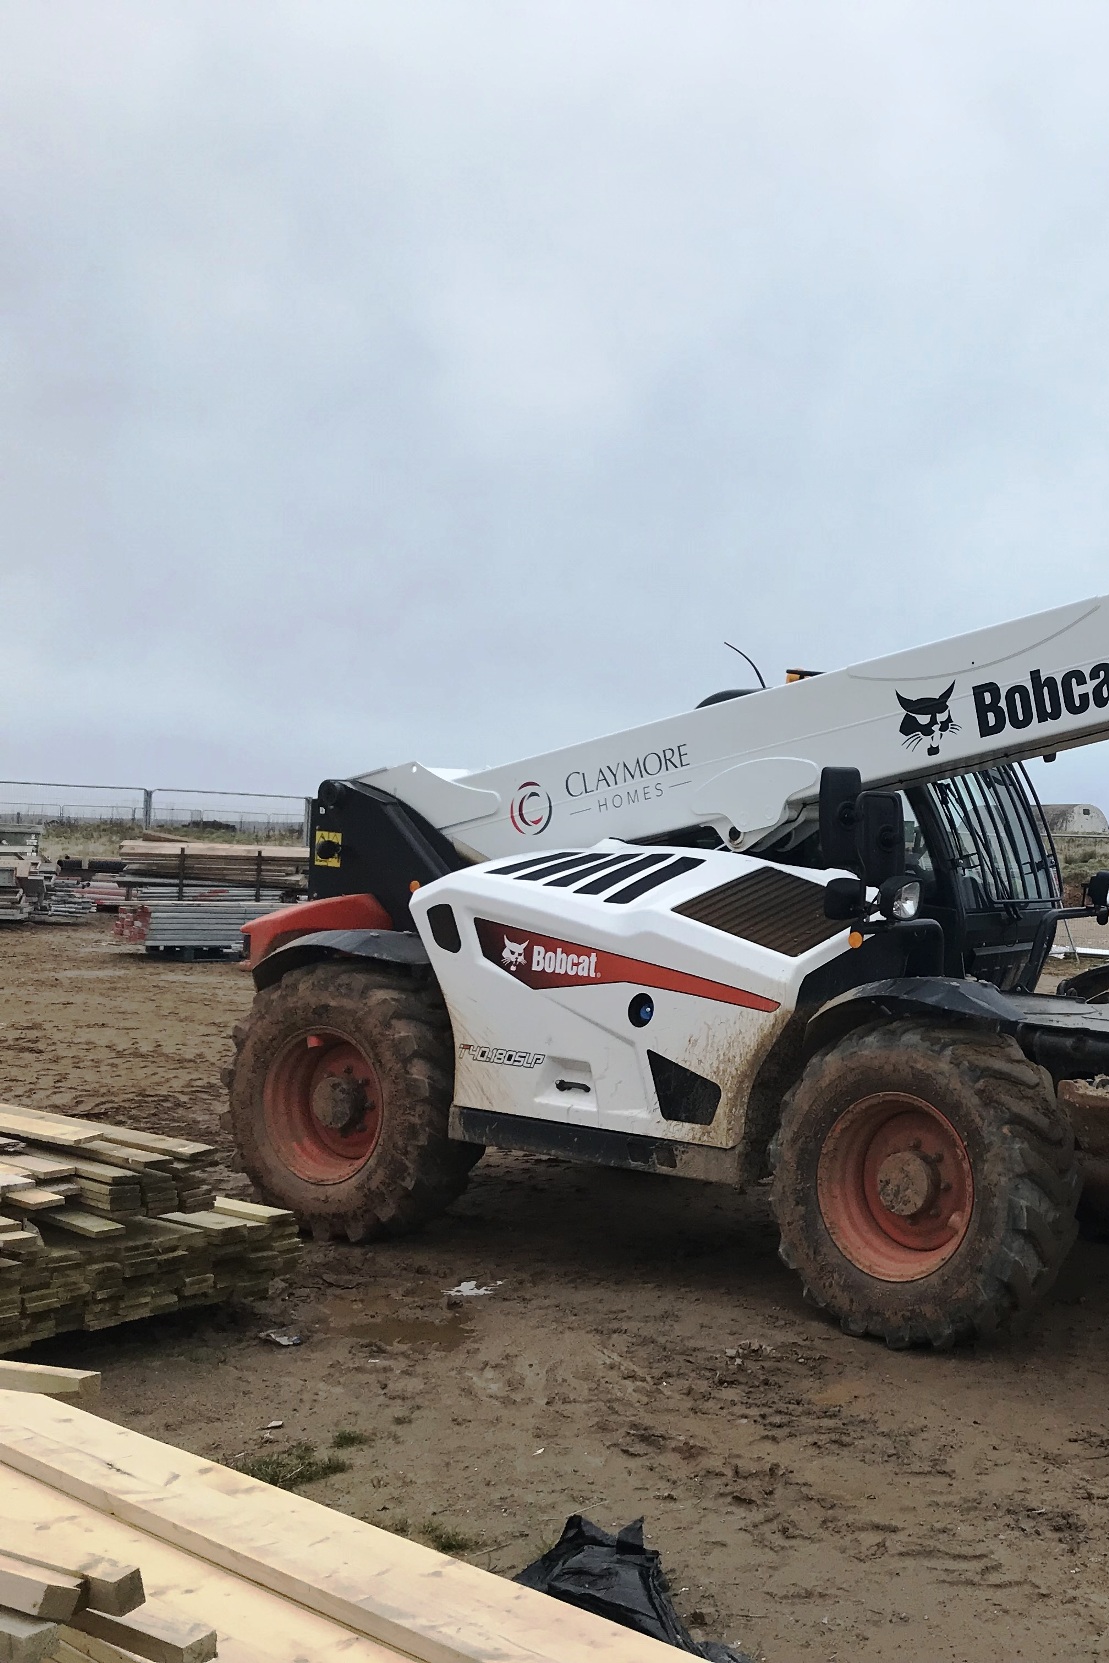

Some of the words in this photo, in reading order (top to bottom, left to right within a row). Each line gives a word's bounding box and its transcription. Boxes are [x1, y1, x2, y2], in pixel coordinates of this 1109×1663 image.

[566, 744, 690, 797] CLAYMORE
[598, 783, 664, 812] HOMES
[532, 945, 597, 978] Bobcat
